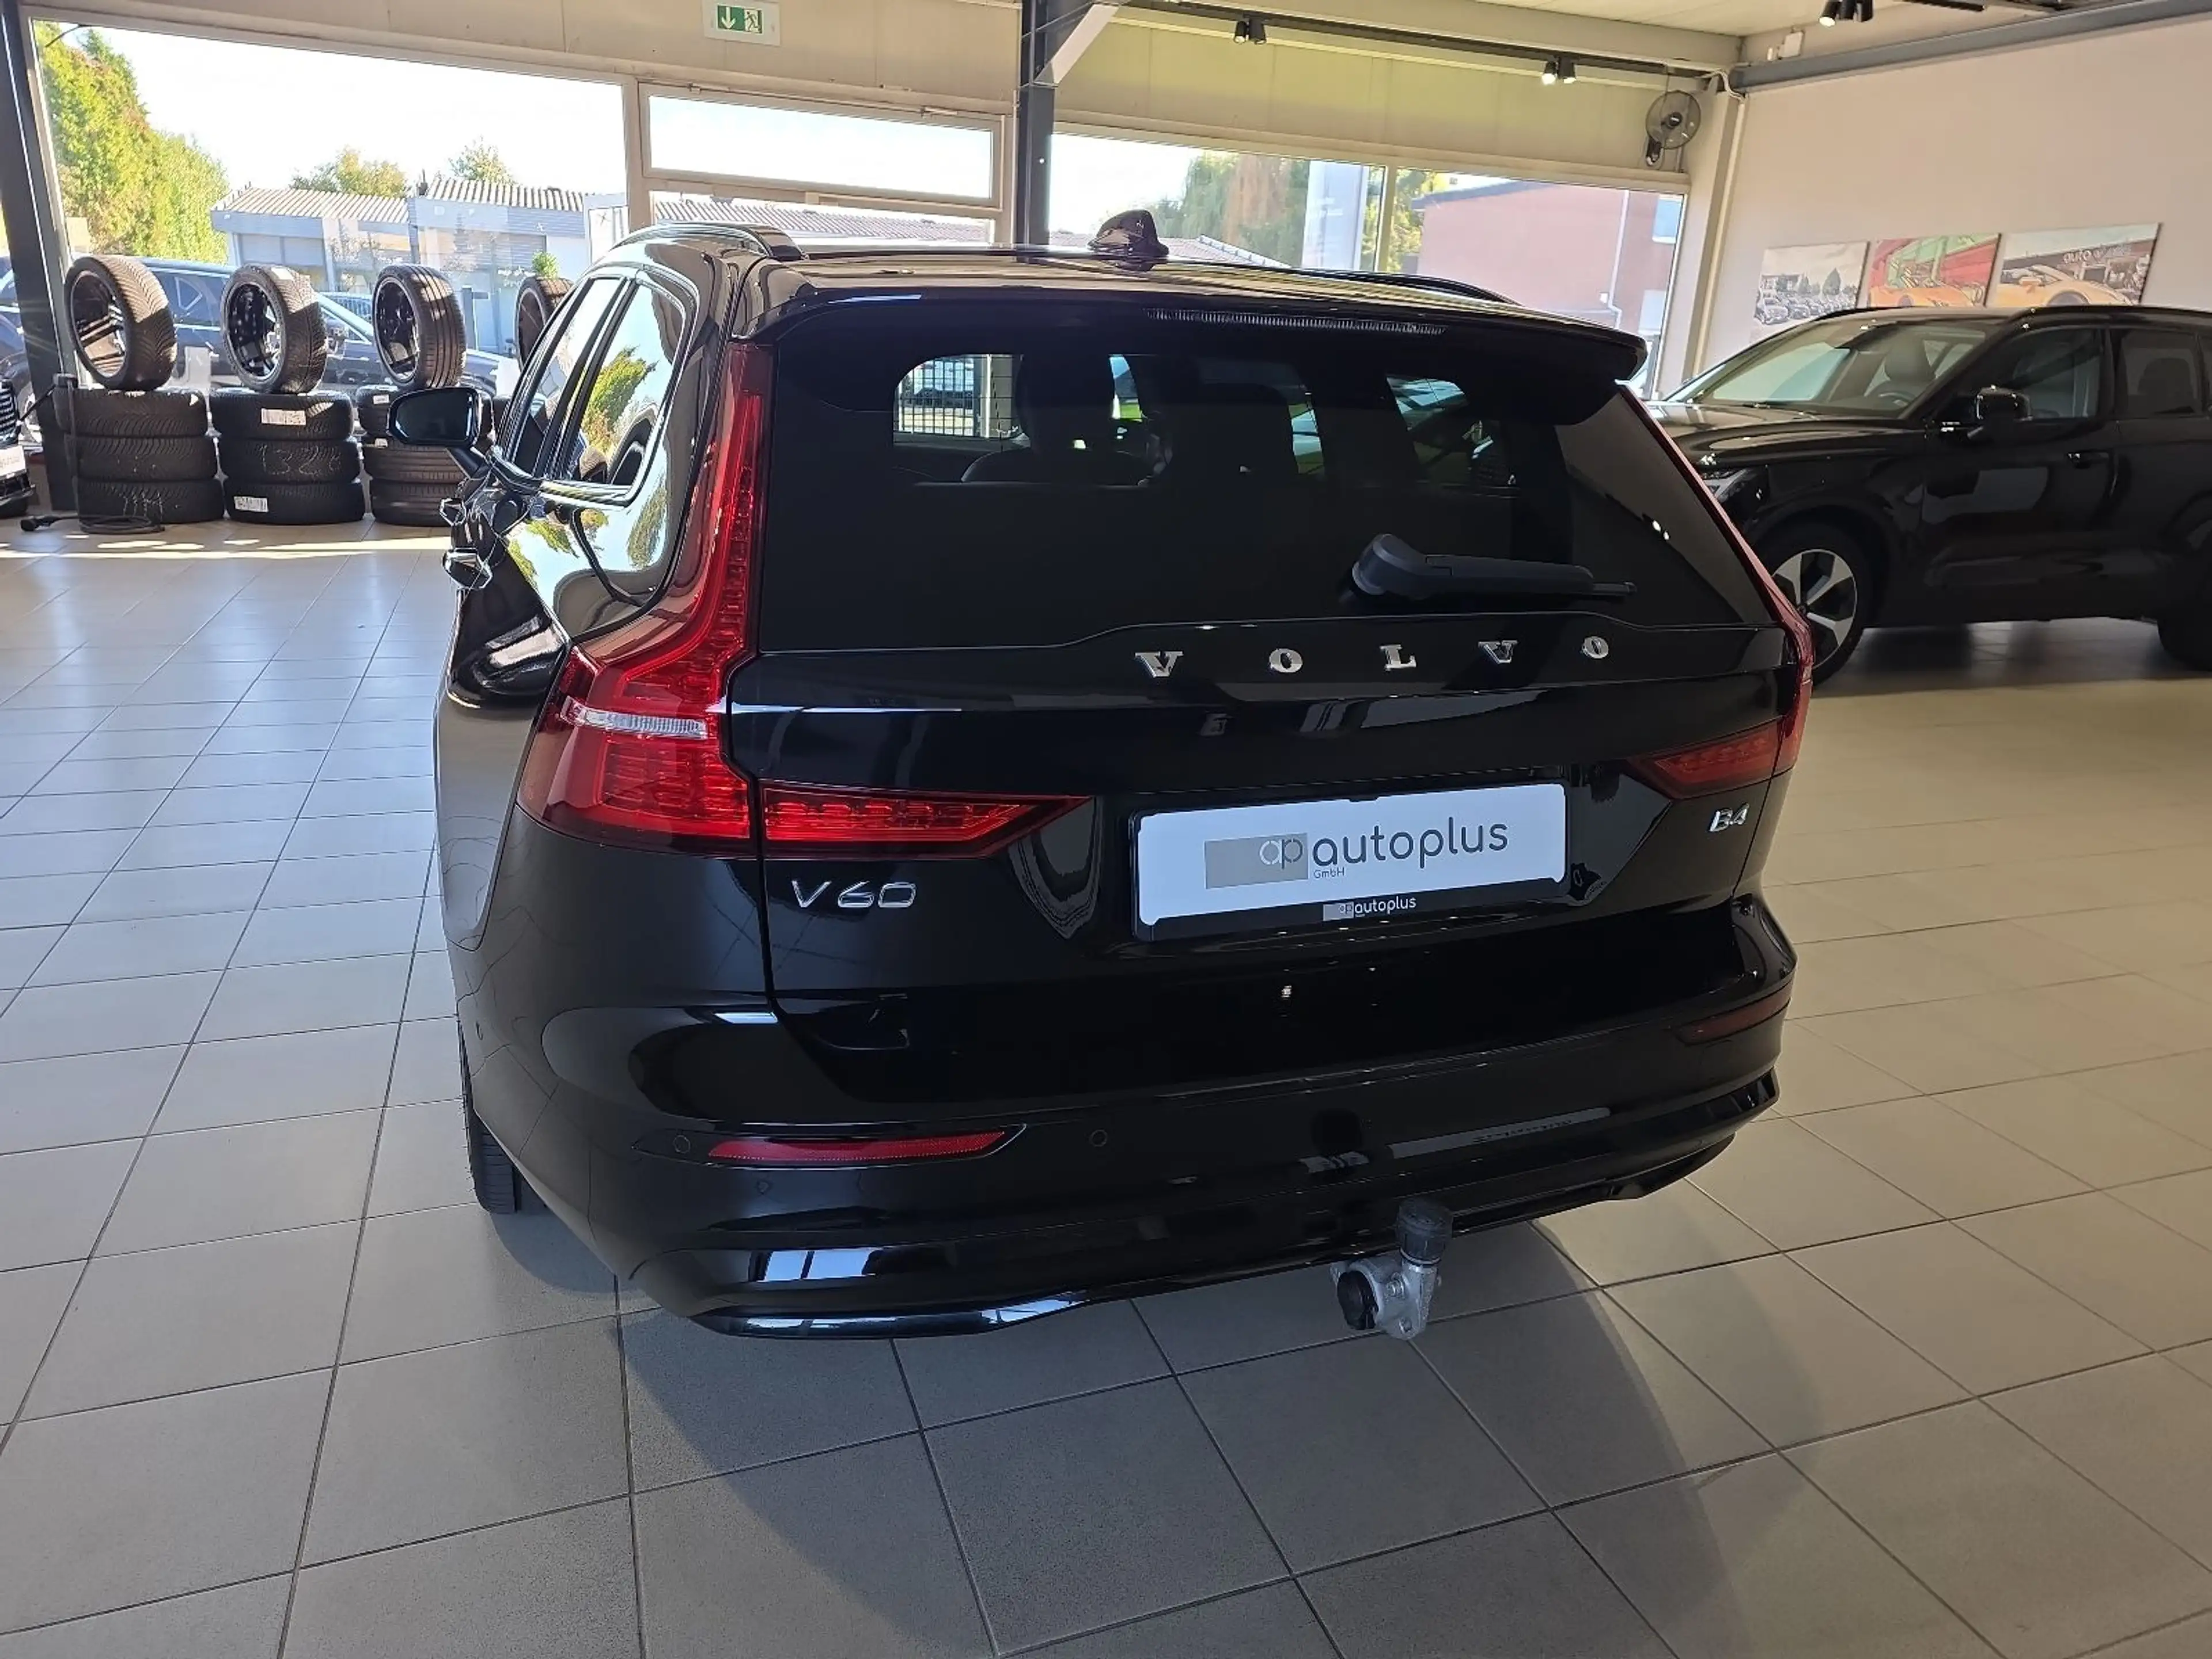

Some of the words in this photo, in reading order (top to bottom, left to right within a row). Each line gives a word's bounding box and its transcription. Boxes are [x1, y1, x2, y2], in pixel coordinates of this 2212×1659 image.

[1135, 635, 1609, 678] VOLVO
[1710, 802, 1749, 831] B4
[1312, 816, 1508, 869] autoplus
[1313, 866, 1345, 879] GmbH
[791, 880, 916, 908] V60
[1354, 896, 1416, 915] autoplus
